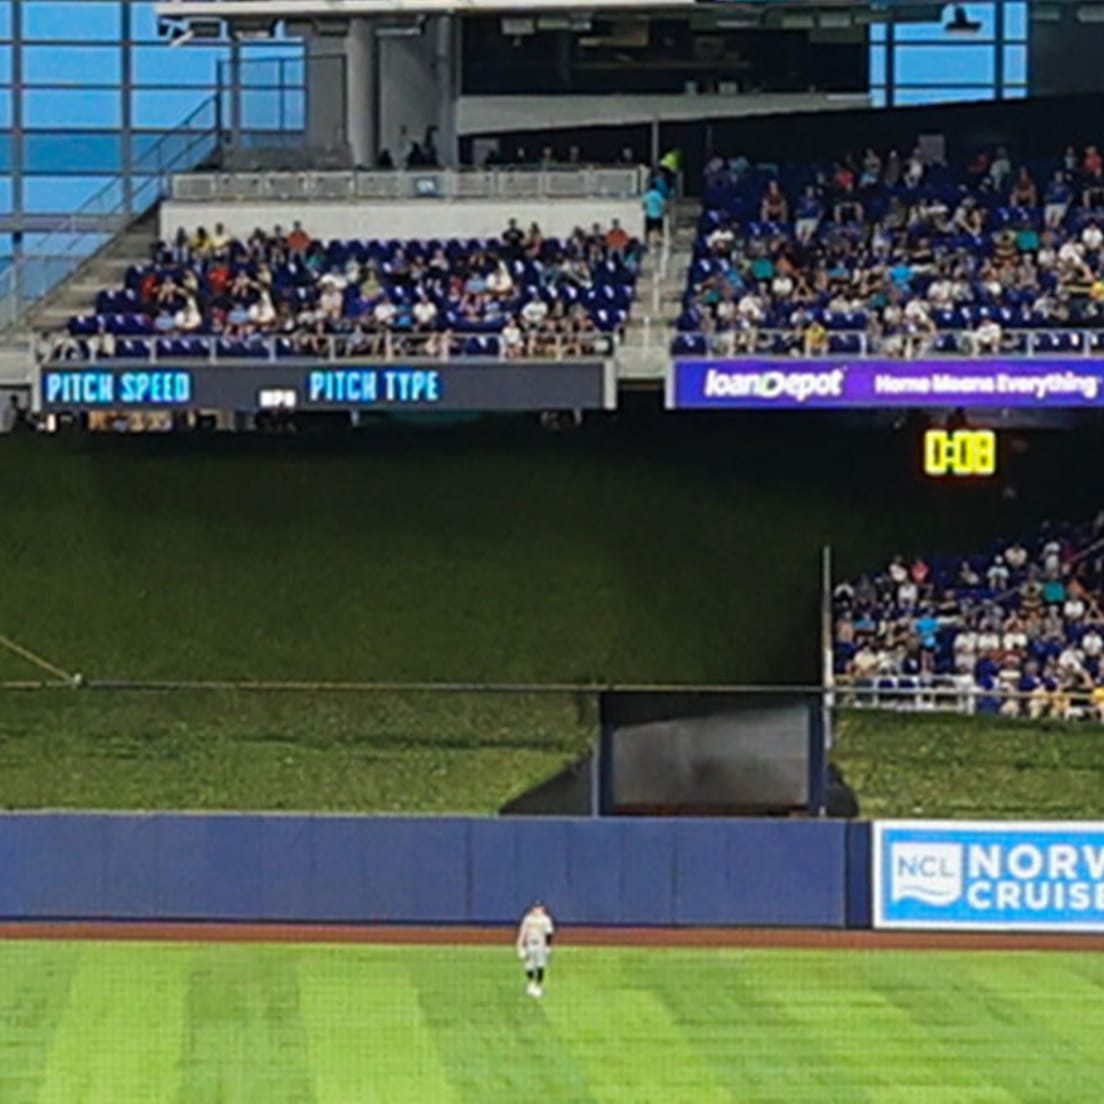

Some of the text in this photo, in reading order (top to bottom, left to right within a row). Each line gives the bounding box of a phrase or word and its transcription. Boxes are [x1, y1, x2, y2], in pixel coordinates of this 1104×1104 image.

[46, 372, 190, 402] PITCH SPEED
[310, 371, 376, 401] PITCH
[385, 371, 439, 400] TYPE
[705, 369, 843, 401] loanDepot
[997, 371, 1098, 398] Everything
[898, 856, 954, 877] NCL
